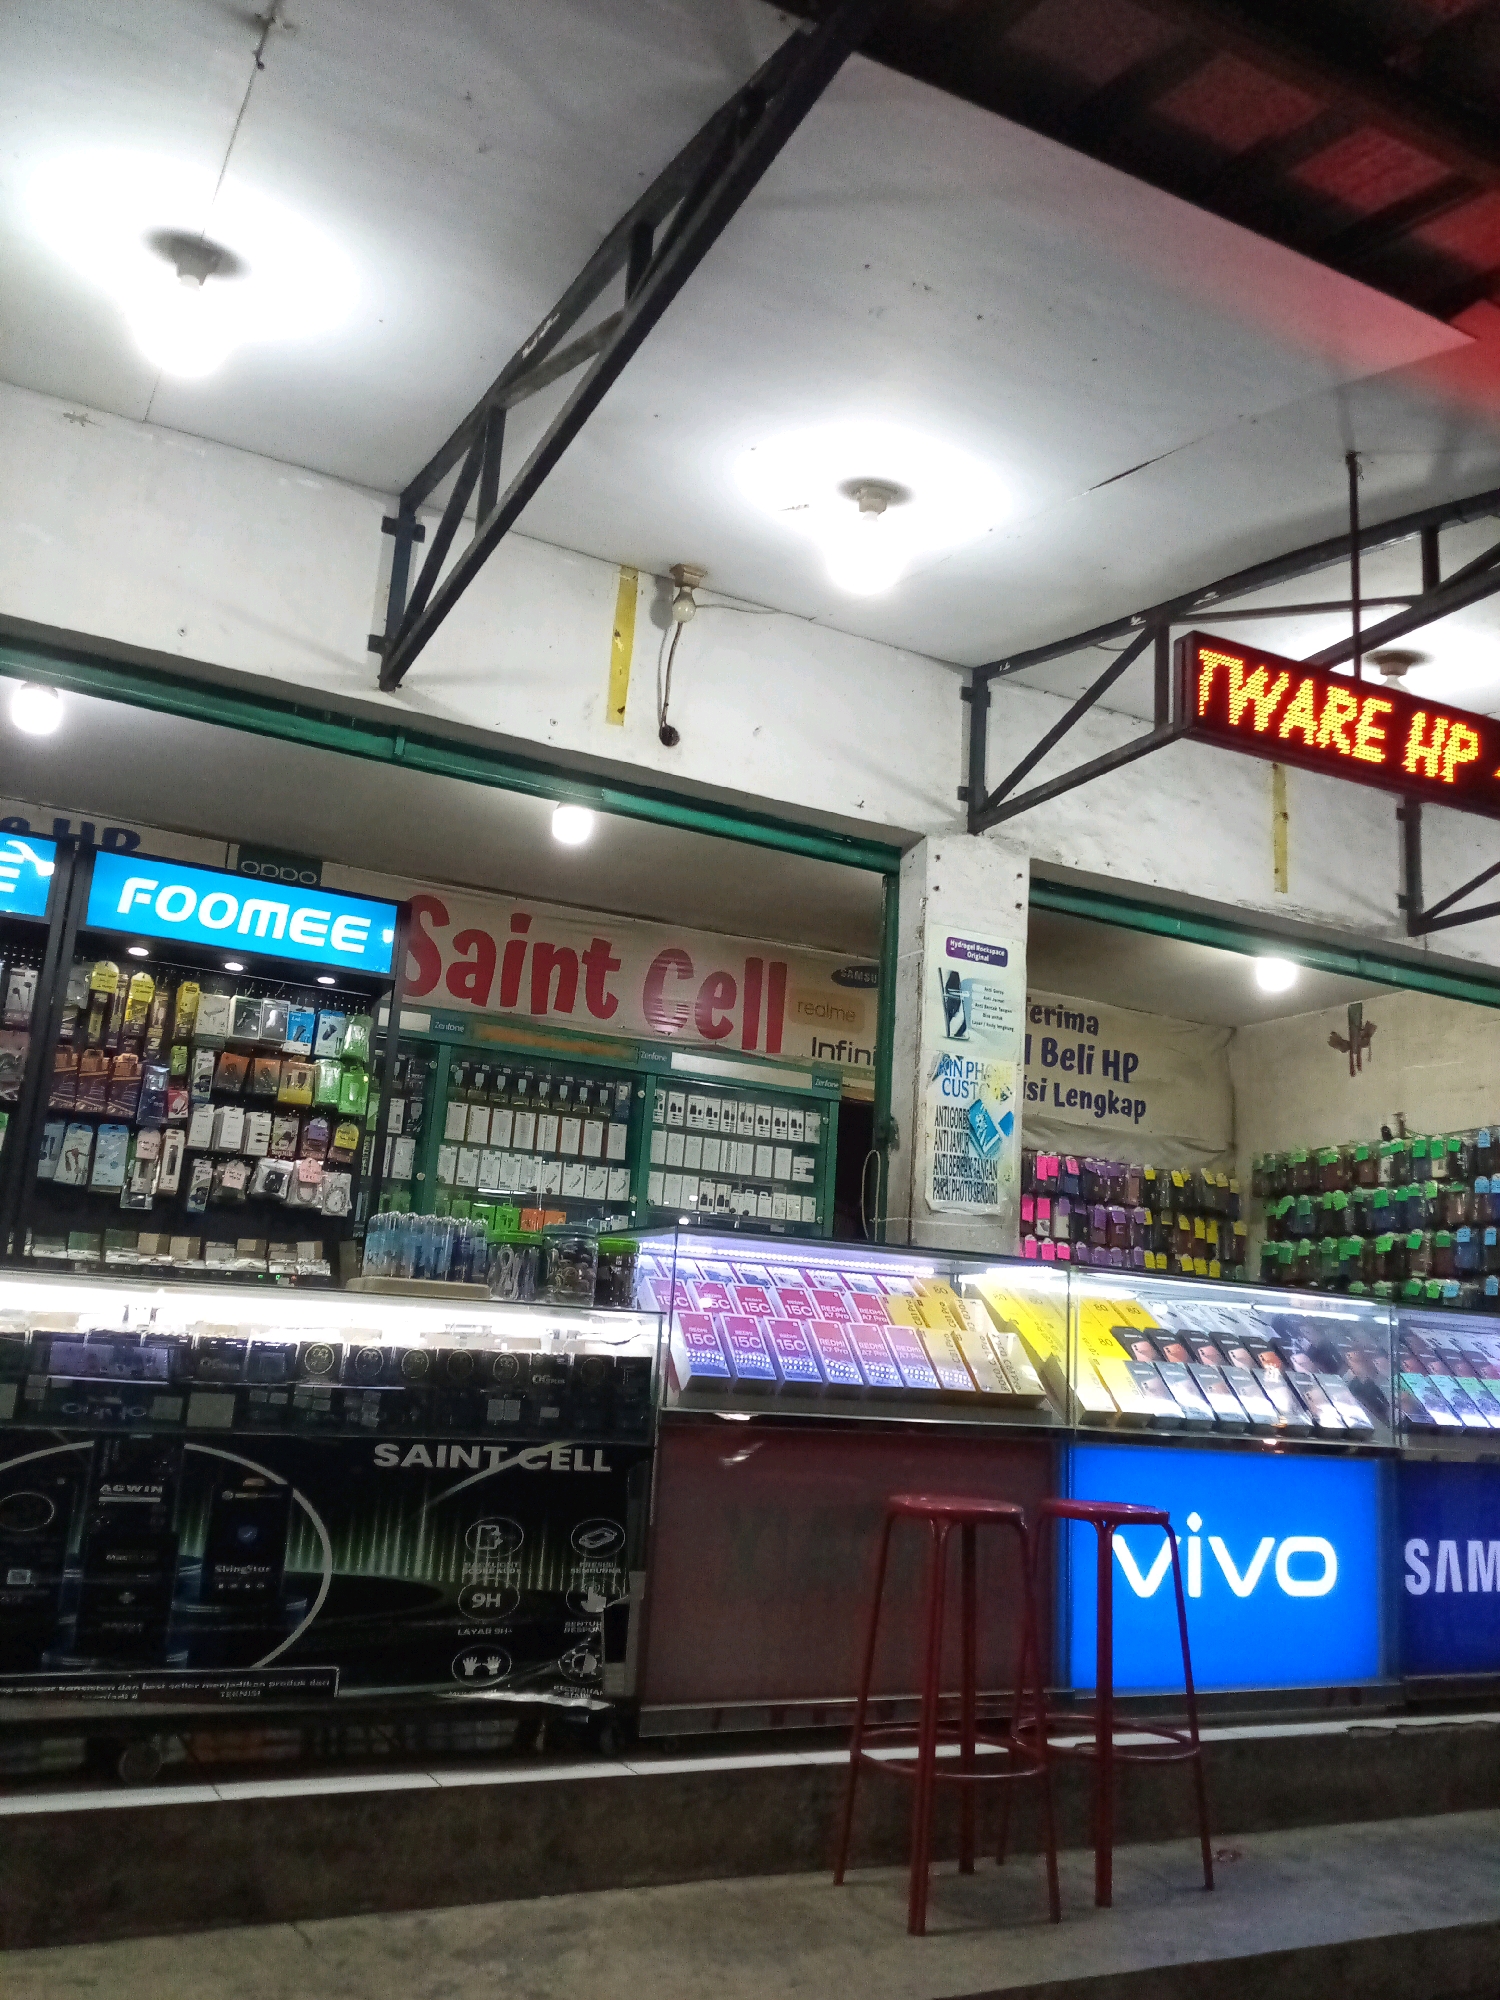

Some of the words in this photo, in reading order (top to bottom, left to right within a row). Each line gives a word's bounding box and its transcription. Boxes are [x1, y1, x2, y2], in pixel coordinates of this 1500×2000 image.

[1401, 711, 1479, 782] HP
[116, 876, 372, 954] FOOMEE
[966, 951, 989, 962] Original
[402, 895, 622, 1020] Saint
[643, 948, 788, 1054] Cell
[797, 1000, 856, 1023] realme
[1041, 1037, 1095, 1075] Beli
[1102, 1049, 1139, 1083] HP
[1053, 1082, 1147, 1124] Lengkap
[741, 1301, 771, 1313] 15C
[784, 1304, 813, 1317] 15C
[685, 1333, 716, 1346] 15C
[731, 1335, 762, 1348] 15C
[776, 1338, 807, 1351] 15C
[373, 1443, 507, 1469] SAINT
[517, 1446, 612, 1473] CELL
[1112, 1512, 1338, 1598] vivo
[1404, 1538, 1500, 1595] SAM
[471, 1592, 502, 1609] 9H
[457, 1627, 492, 1636] LAYAR
